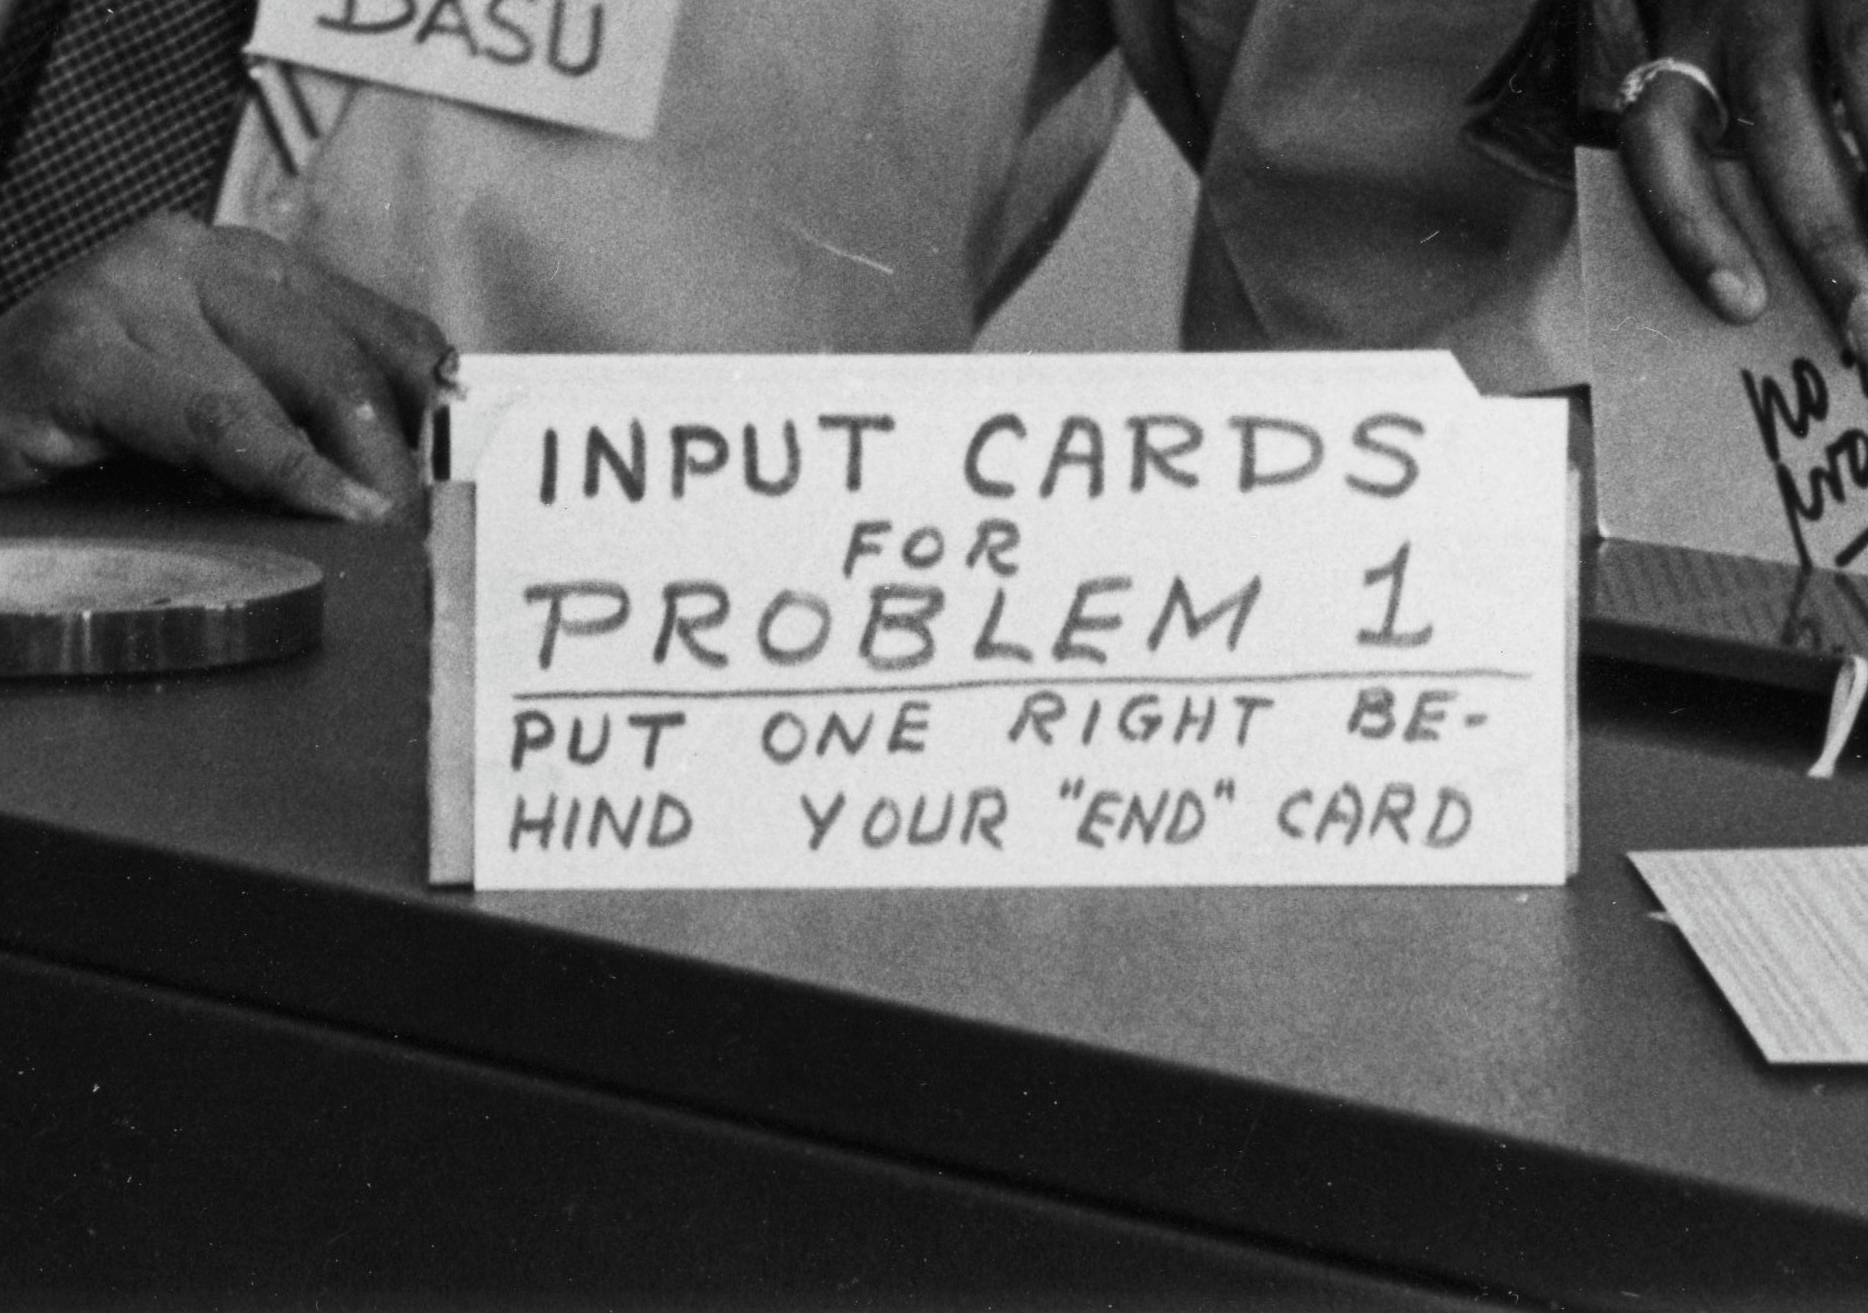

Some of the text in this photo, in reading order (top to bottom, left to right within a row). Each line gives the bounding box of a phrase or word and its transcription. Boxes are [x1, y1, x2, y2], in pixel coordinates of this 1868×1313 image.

[538, 412, 1426, 504] INPUT CARDS
[842, 518, 1022, 579] FOR
[523, 542, 1434, 671] PROBLEM 1
[510, 687, 1488, 772] PUT ONE RIGHT BE-
[509, 777, 1473, 853] HIND YOUR "END" CARD
